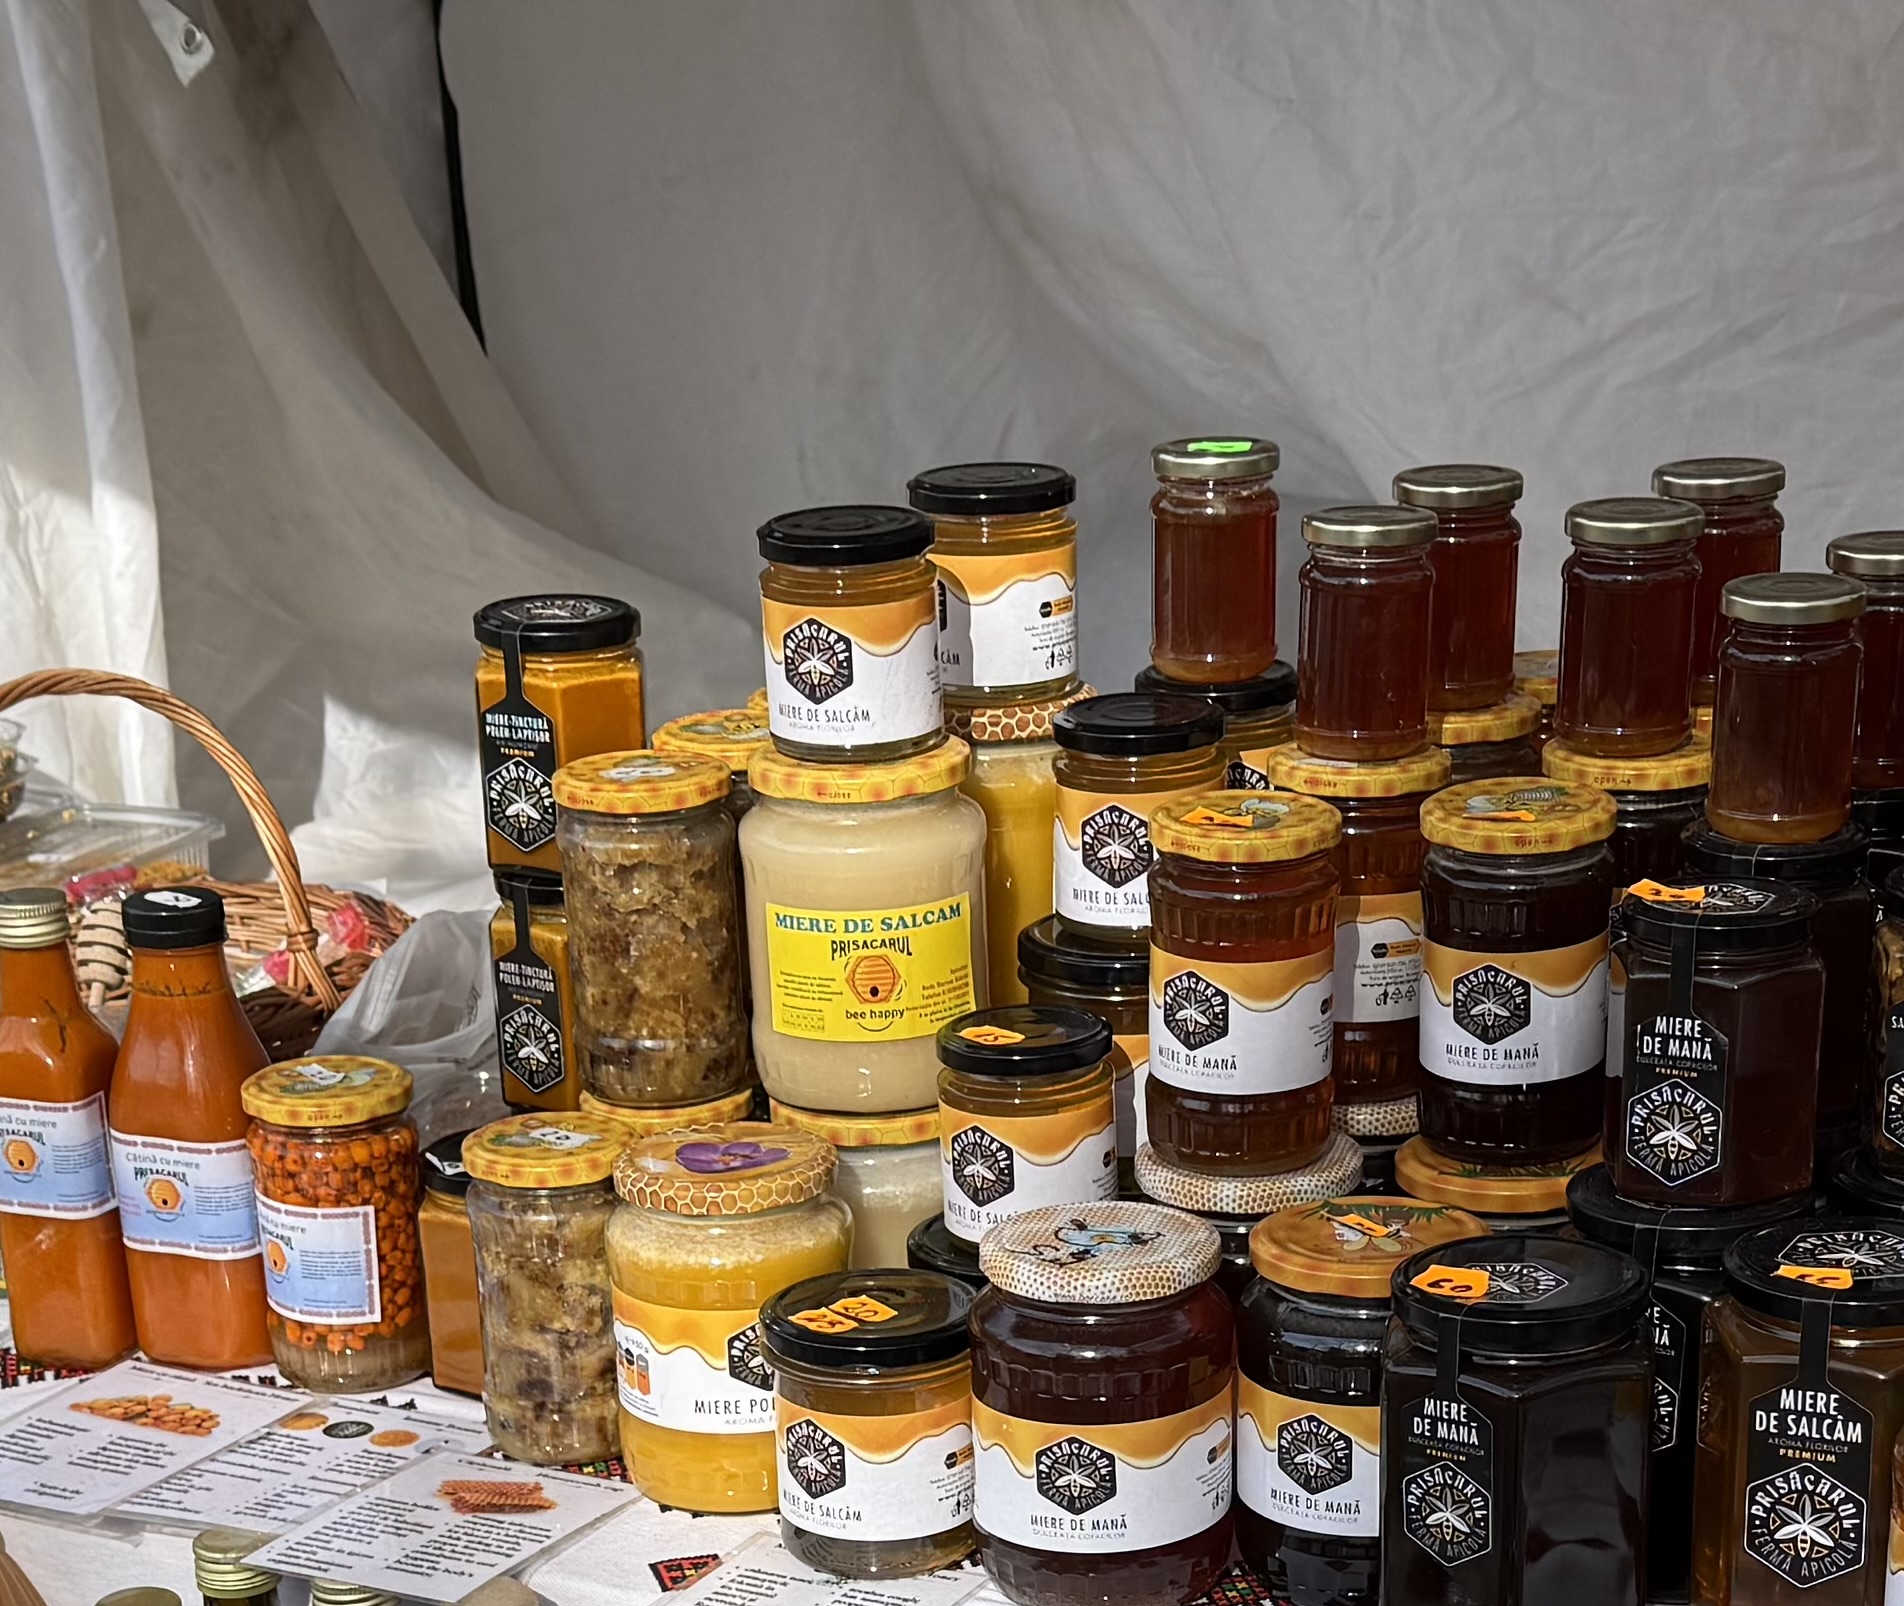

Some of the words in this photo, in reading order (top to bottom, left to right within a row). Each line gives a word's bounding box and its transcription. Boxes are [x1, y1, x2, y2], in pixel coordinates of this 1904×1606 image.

[785, 623, 850, 661] PRISACARUL
[774, 912, 837, 933] MIERE
[843, 918, 874, 933] DE
[880, 902, 961, 931] SALCAM
[831, 936, 912, 961] PRISACARUL
[846, 1009, 866, 1020] bee
[870, 1009, 905, 1021] happy
[1655, 1016, 1702, 1038] MIERE
[1643, 1036, 1663, 1054] DE
[1667, 1038, 1713, 1061] MANĂ
[1630, 1086, 1718, 1134] PRISACARUL
[1780, 1388, 1839, 1415] MIERE
[1755, 1410, 1779, 1434] DE
[1787, 1414, 1863, 1444] SALCÂM
[1779, 1448, 1836, 1464] PREMIUM
[1751, 1471, 1861, 1529] PRISACARUL
